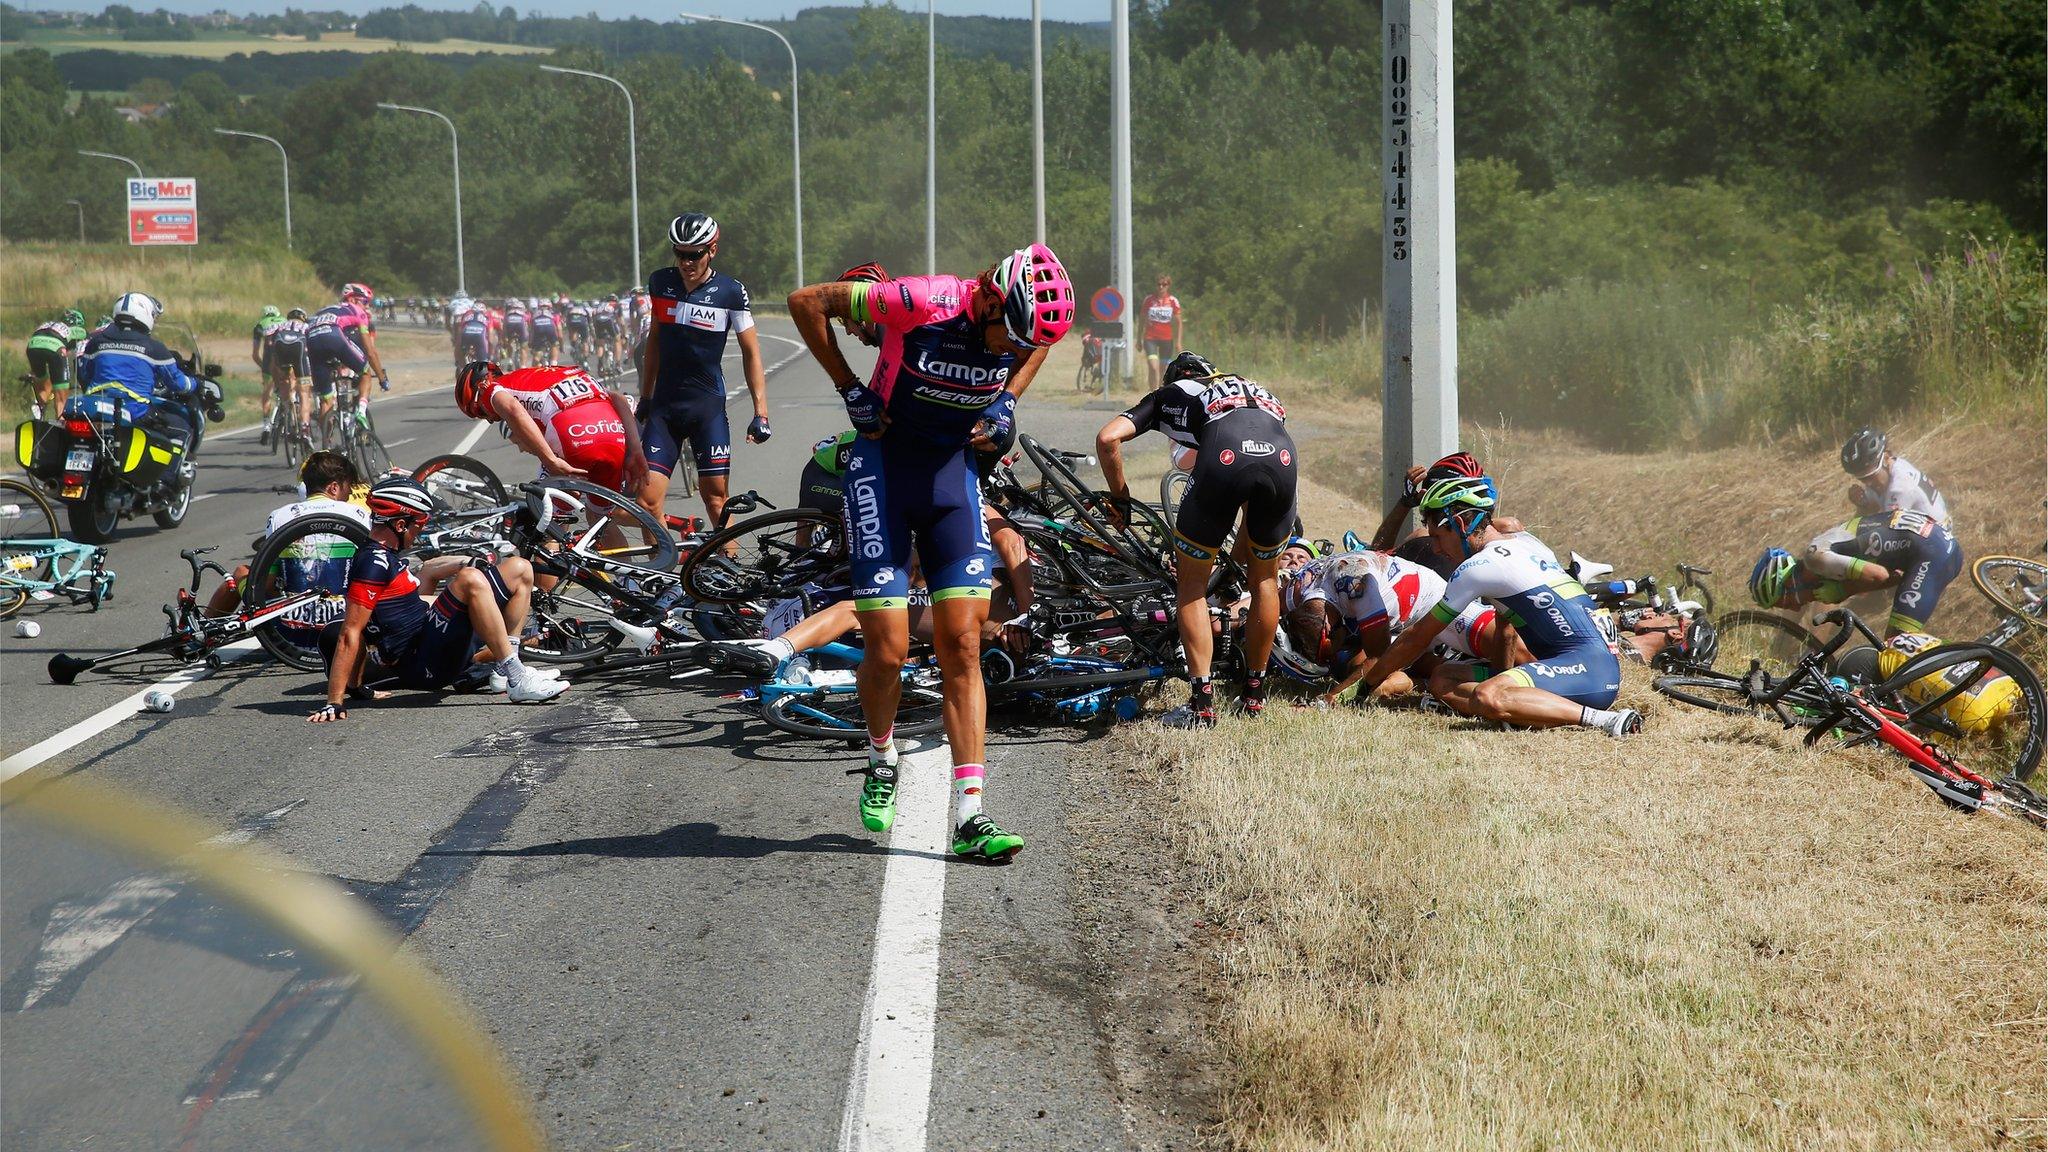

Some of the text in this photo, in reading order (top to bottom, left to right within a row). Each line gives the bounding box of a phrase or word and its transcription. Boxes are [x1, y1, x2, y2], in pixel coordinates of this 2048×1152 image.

[130, 181, 192, 200] BigMat
[690, 306, 716, 322] IAM
[98, 342, 147, 354] GENDARMERIE
[917, 351, 1009, 386] Lampre
[553, 378, 589, 400] 176
[1202, 378, 1239, 404] 215
[711, 444, 730, 456] IAM
[842, 496, 854, 554] MERIDA
[854, 475, 884, 559] Lampre
[1176, 540, 1205, 557] MTN
[1883, 539, 1912, 551] ORICA
[1459, 558, 1490, 571] ORICA
[1911, 560, 1931, 590] ORICA
[1546, 608, 1575, 638] ORICA
[1552, 663, 1588, 676] ORICA
[2024, 686, 2042, 766] DURA-ACE
